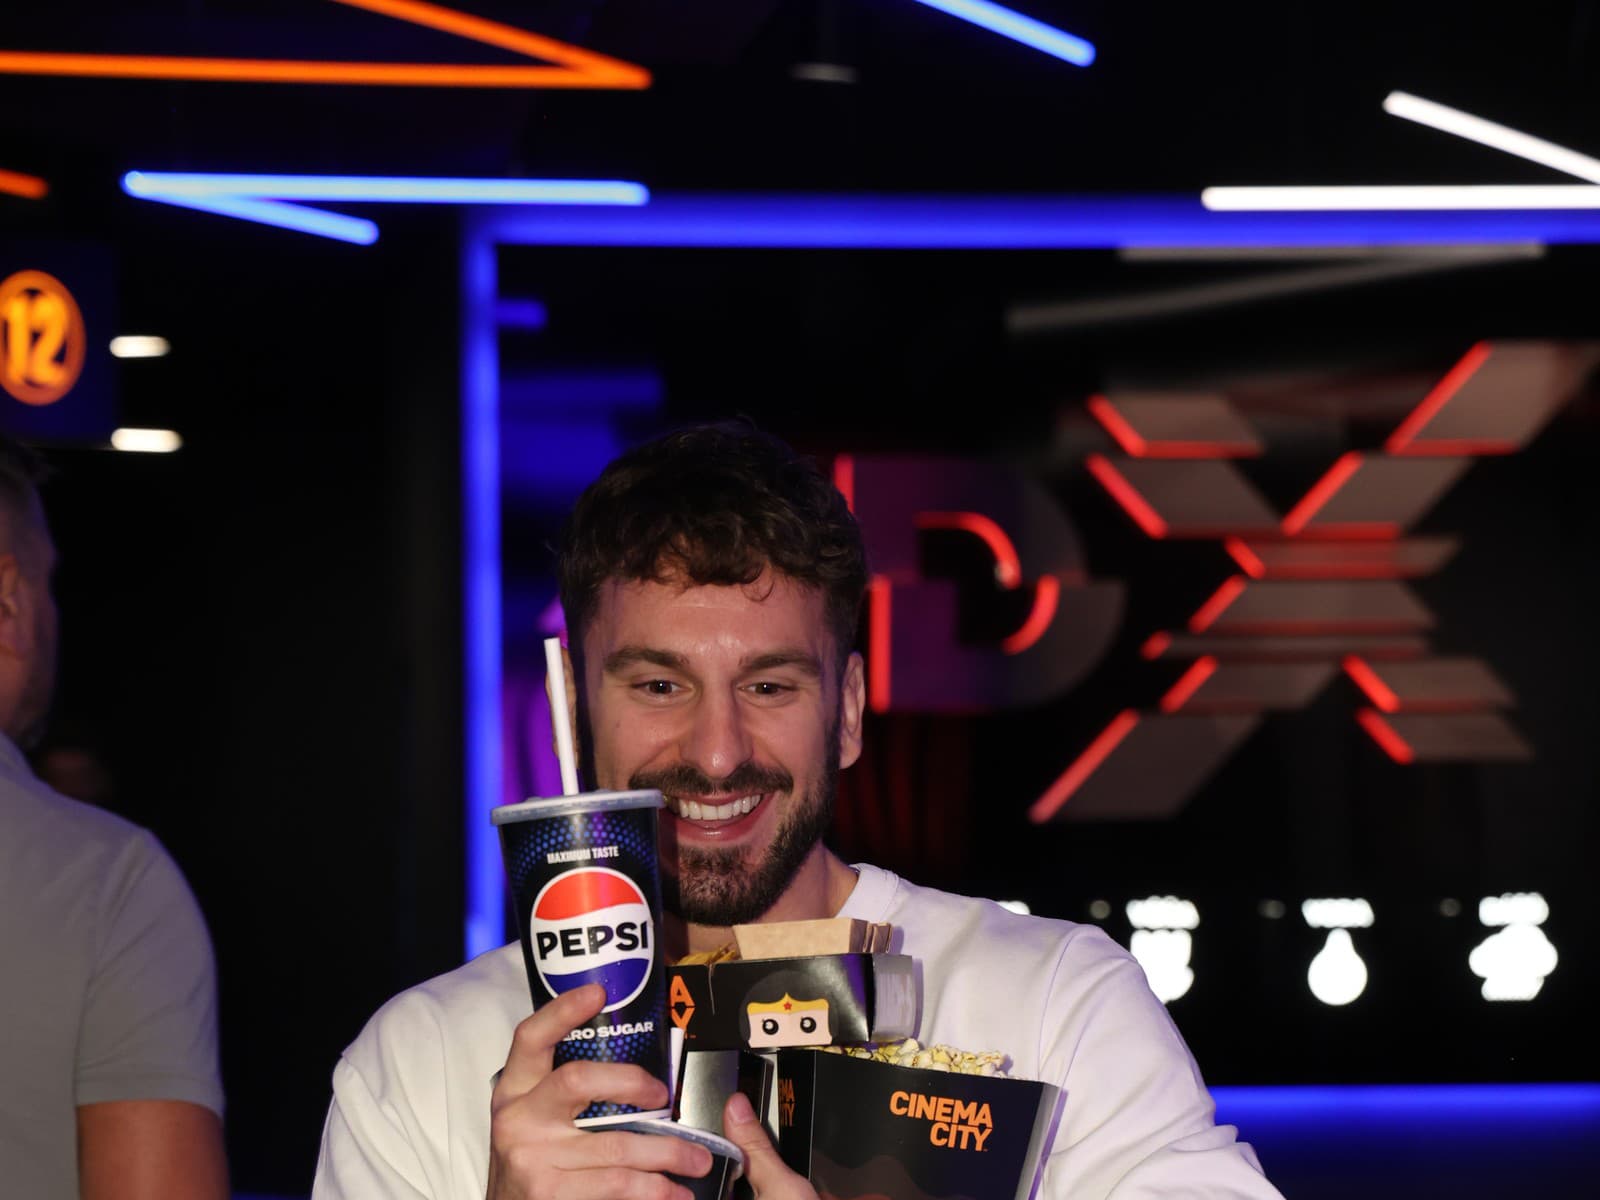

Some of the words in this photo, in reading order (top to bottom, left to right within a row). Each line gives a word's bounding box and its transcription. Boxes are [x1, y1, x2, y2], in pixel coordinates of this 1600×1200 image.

[2, 294, 69, 386] 12
[833, 340, 1598, 820] DX
[546, 848, 591, 865] MAXIMUM
[592, 845, 619, 859] TASTE
[536, 920, 649, 961] PEPSI
[563, 1027, 596, 1042] RO
[597, 1021, 655, 1038] SUGAR
[889, 1090, 993, 1129] CINEMA
[930, 1121, 993, 1152] CITY
